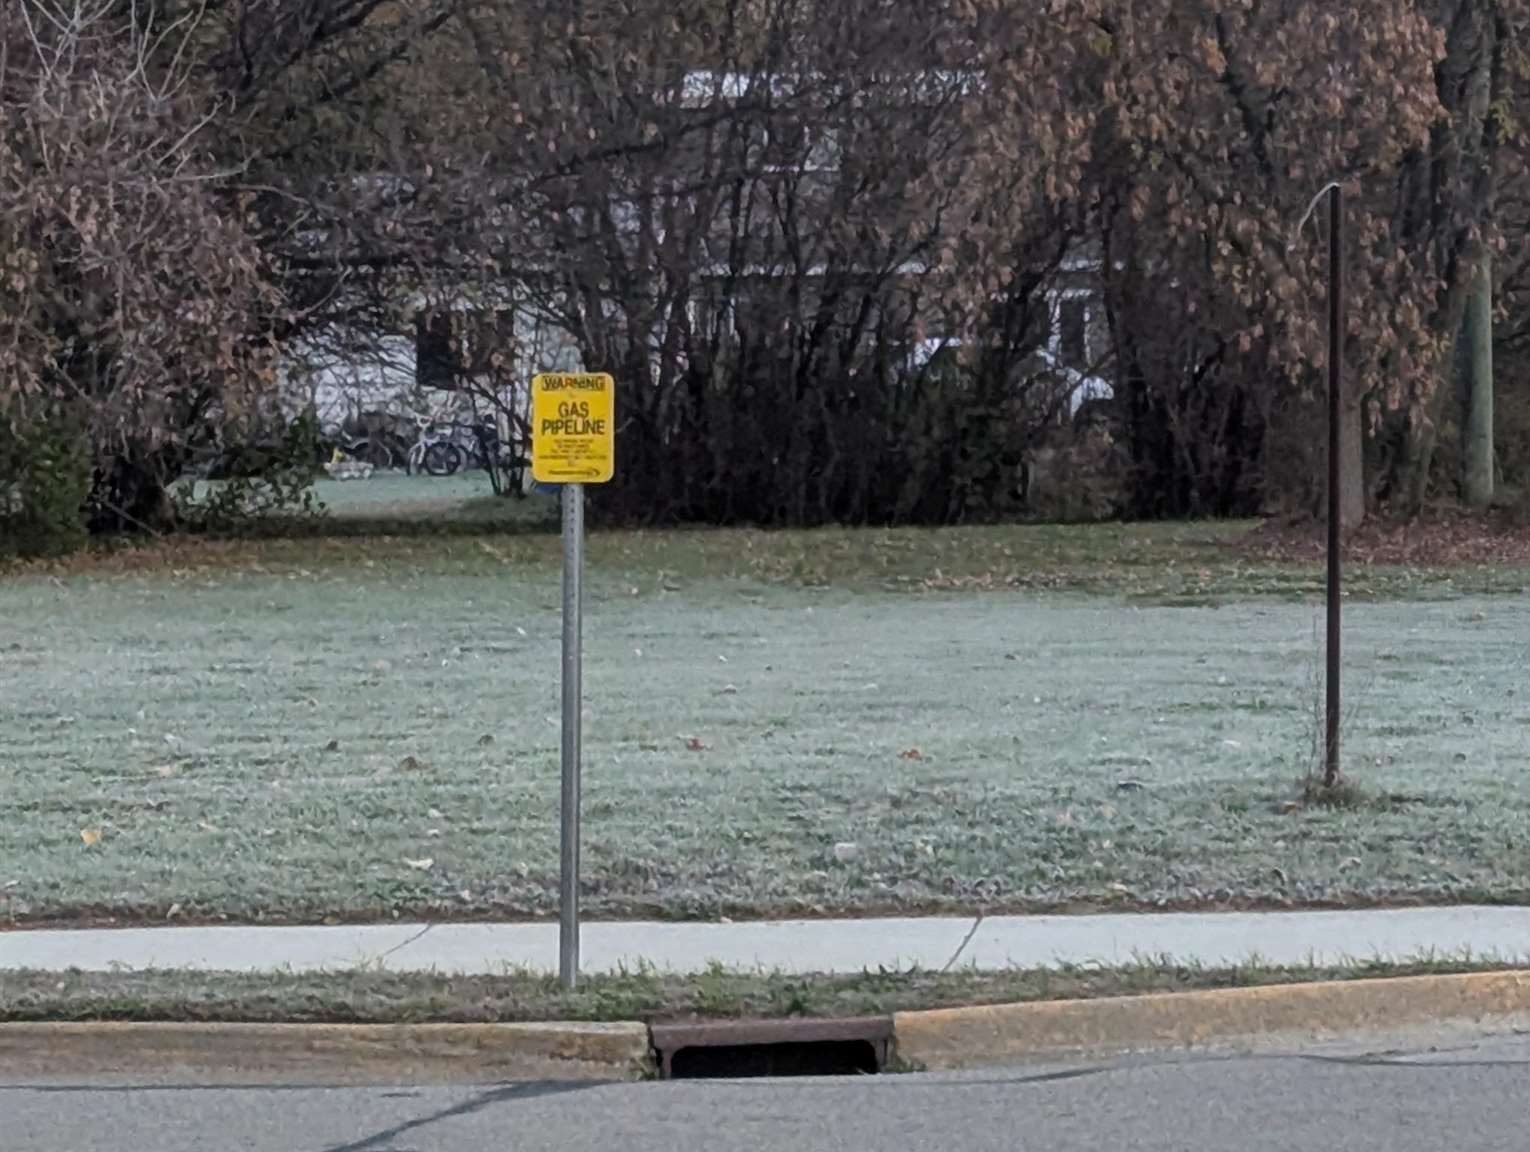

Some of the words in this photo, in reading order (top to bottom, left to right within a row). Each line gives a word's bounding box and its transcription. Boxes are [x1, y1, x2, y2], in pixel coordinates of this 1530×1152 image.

[543, 376, 605, 390] WARNING
[558, 401, 590, 417] GAS
[542, 419, 605, 435] PIPELINE
